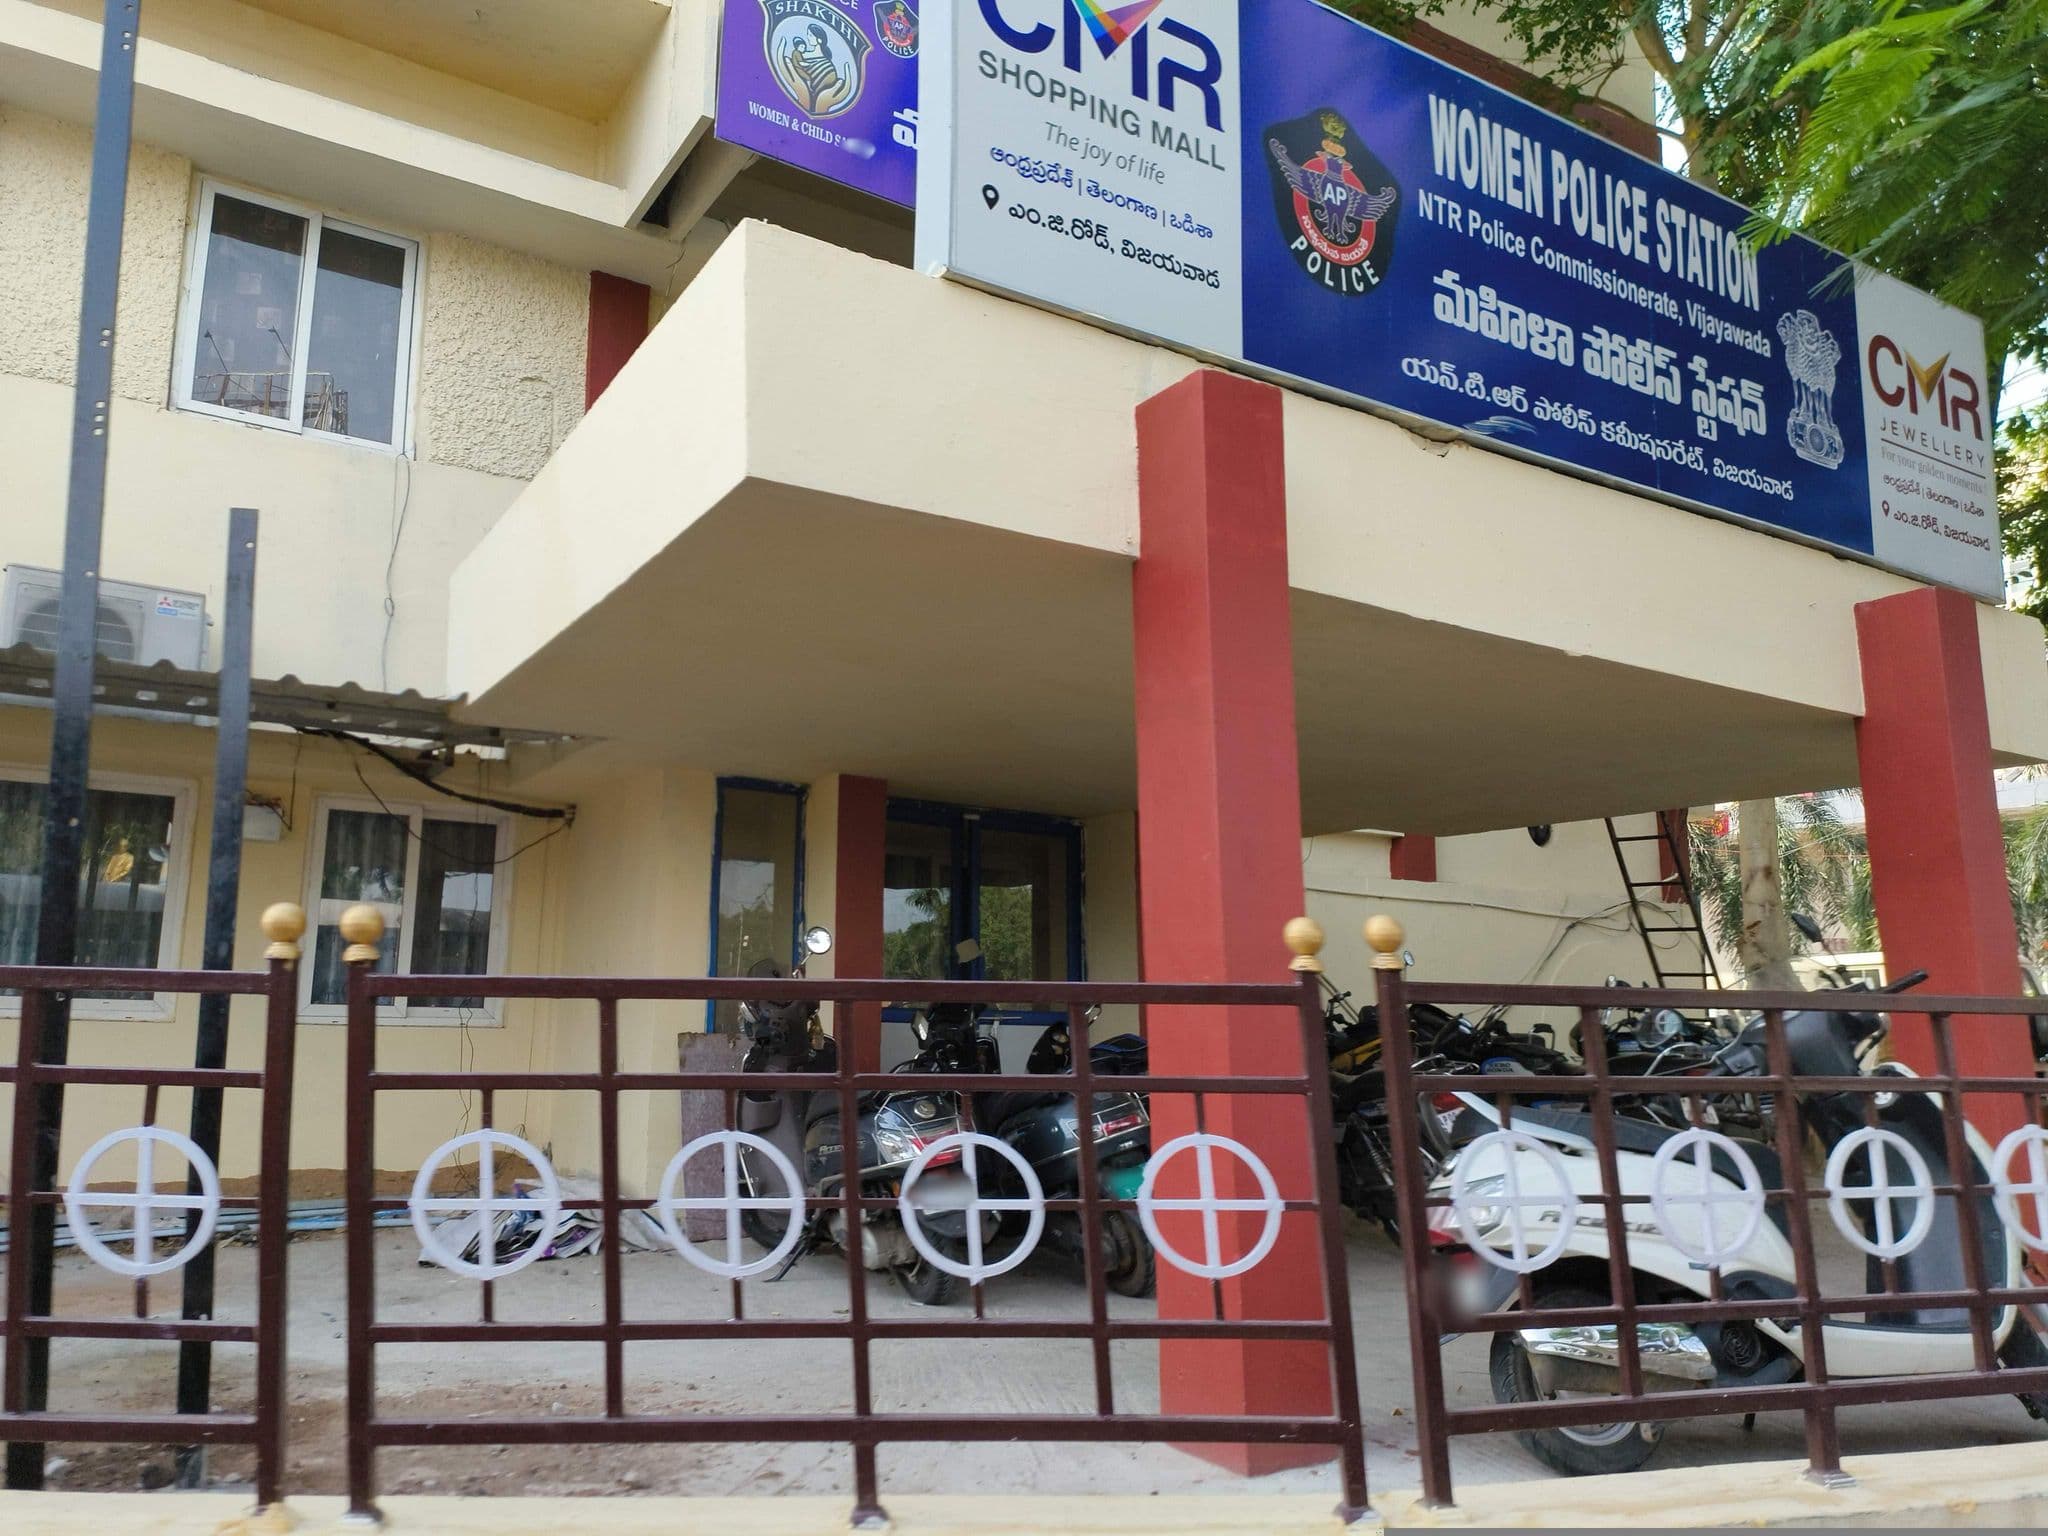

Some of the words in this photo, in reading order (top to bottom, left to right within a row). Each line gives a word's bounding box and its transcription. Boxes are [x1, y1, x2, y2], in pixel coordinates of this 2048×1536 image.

[775, 0, 859, 49] SHAKTHI
[882, 36, 914, 55] POLICE
[978, 0, 1225, 133] CMR
[748, 101, 790, 127] WOMEN
[791, 118, 800, 132] &
[801, 121, 834, 144] CHILD
[978, 50, 1141, 138] SHOPPING
[1152, 120, 1226, 171] MALL
[1045, 122, 1079, 151] The
[1080, 138, 1113, 167] joy
[1115, 154, 1136, 176] of
[1138, 158, 1166, 184] life
[1086, 179, 1158, 220] తెలంగాణ
[1324, 183, 1347, 205] AP
[1428, 94, 1544, 218] WOMEN
[1551, 149, 1650, 264] POLICE
[1656, 198, 1760, 312] STATION
[1120, 239, 1221, 289] విజయవాడ
[1290, 235, 1380, 292] POLICE
[1418, 189, 1463, 233] NTR
[1468, 210, 1526, 257] Police
[1530, 236, 1683, 327] Commissionerate,
[1686, 299, 1772, 358] Vijayawada
[1433, 269, 1575, 368] మహిళా
[1582, 324, 1682, 406] పోలీస్
[1687, 355, 1767, 442] స్టేషన్
[1868, 335, 1984, 441] CMR
[1533, 396, 1597, 436] పోలీస్
[1713, 457, 1794, 501] విజయవాడ
[1880, 417, 1985, 468] JEWELLERY
